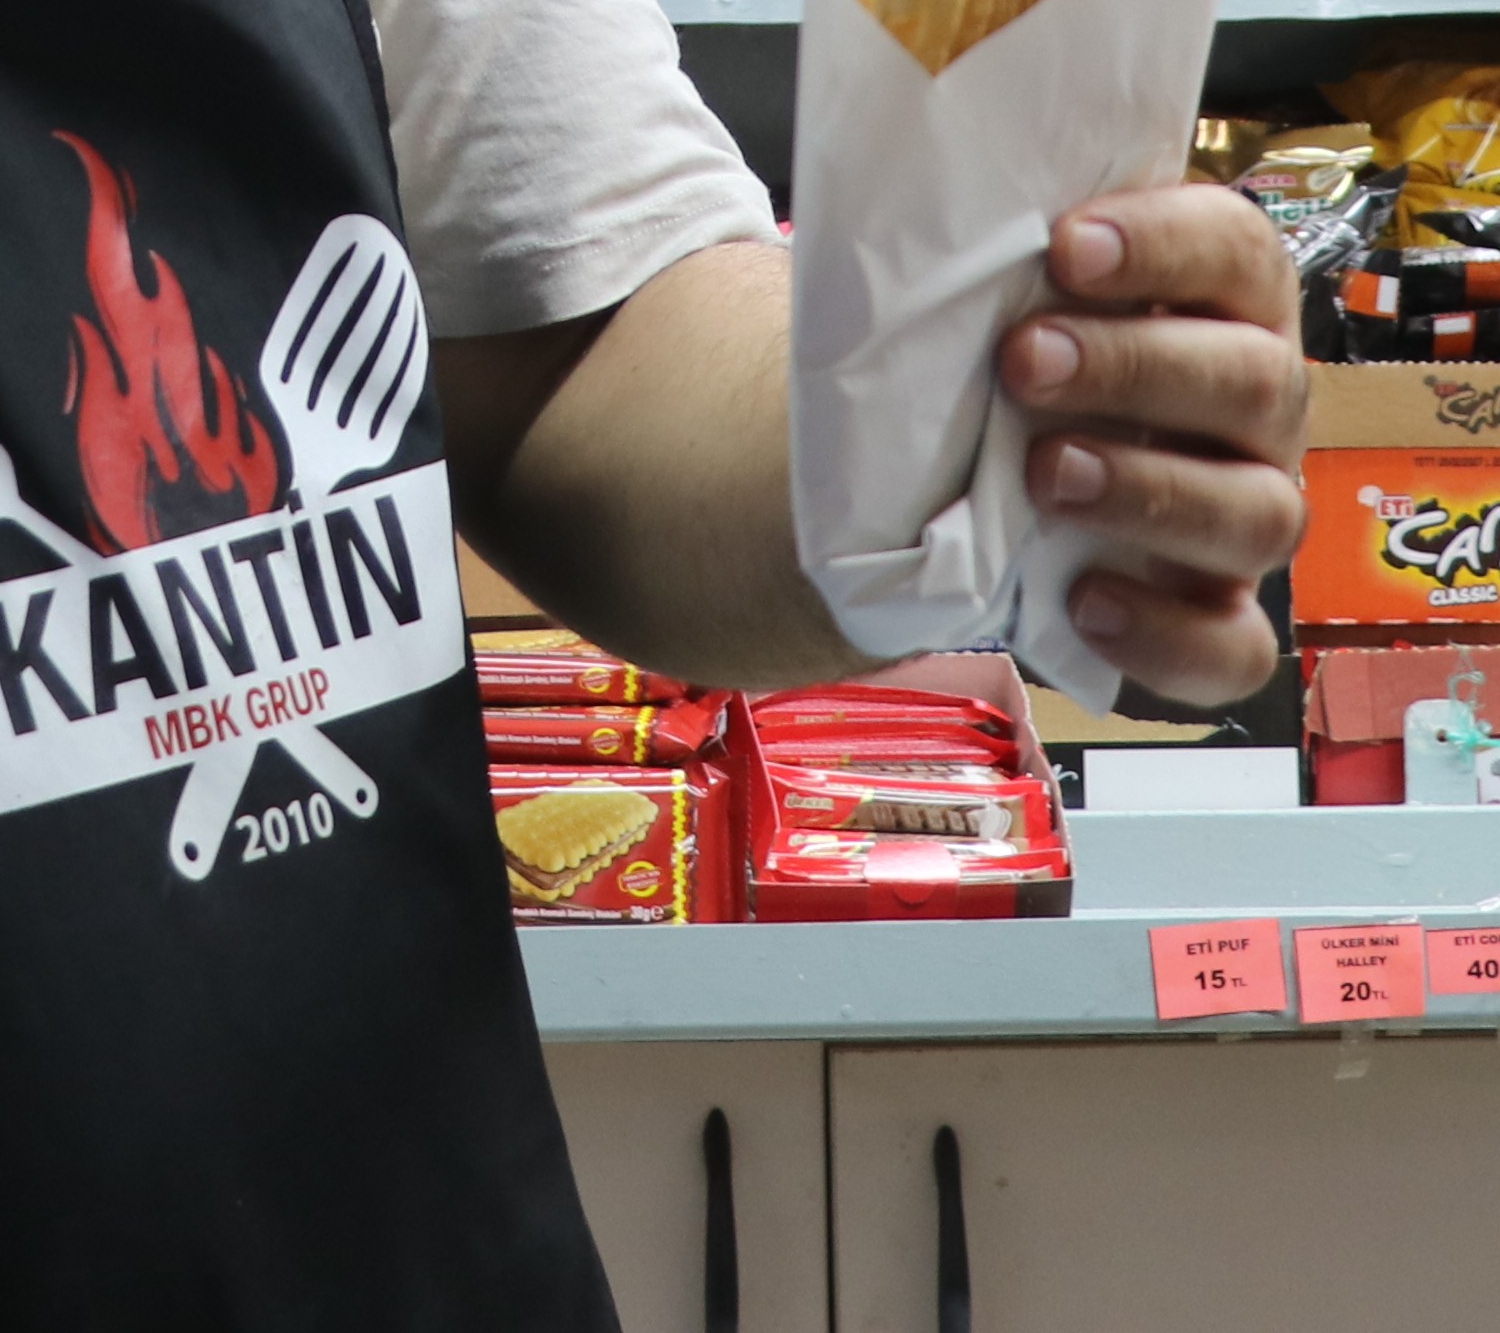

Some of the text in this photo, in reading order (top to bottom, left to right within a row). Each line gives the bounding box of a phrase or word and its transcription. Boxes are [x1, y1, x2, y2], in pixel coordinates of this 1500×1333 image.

[1429, 586, 1498, 606] CLASSIC
[144, 667, 331, 760] MBK GRUP
[234, 792, 335, 862] 2010
[1186, 938, 1250, 956] ETİ PUF
[1322, 935, 1399, 949] ÜLKER MİNİ
[1454, 935, 1475, 946] ETİ
[1337, 956, 1387, 968] HALLEY
[1468, 960, 1499, 979] 40
[1195, 969, 1247, 991] 15 TL
[1341, 982, 1388, 1003] 20 TL
